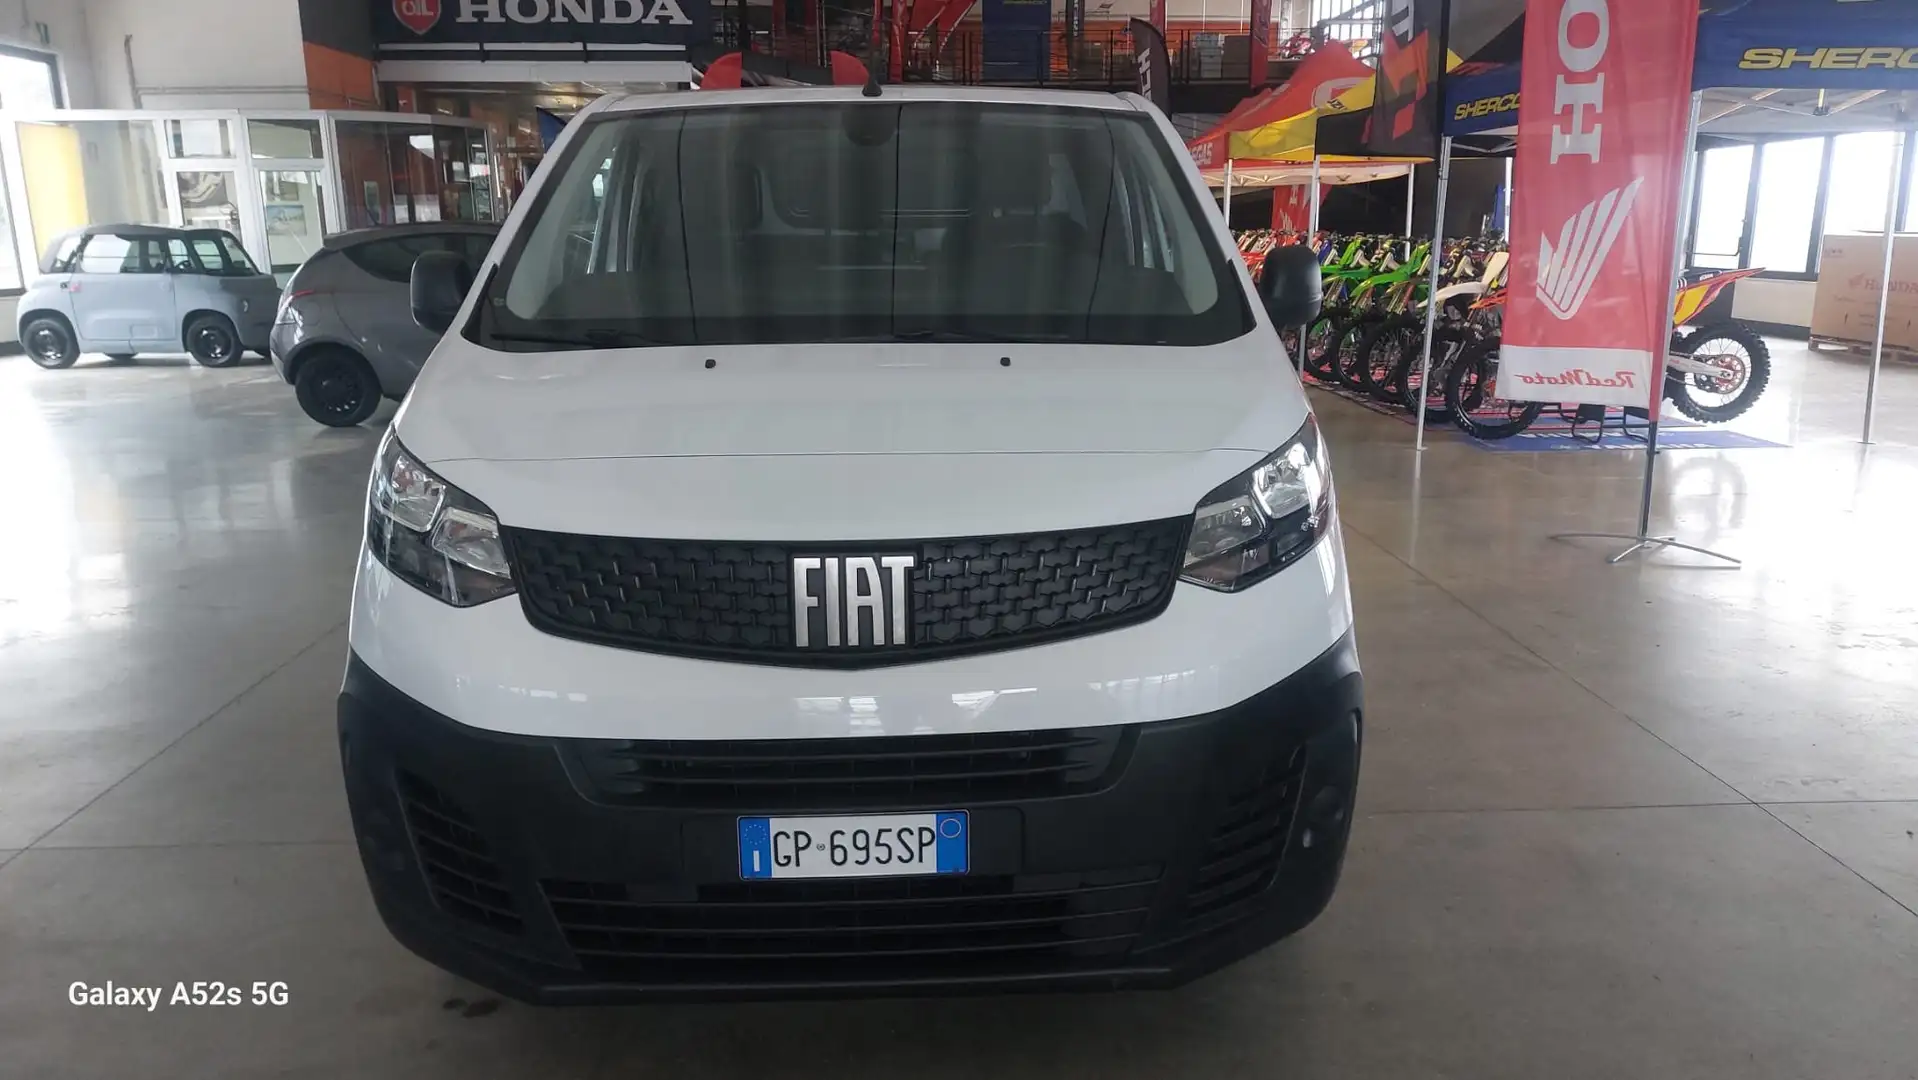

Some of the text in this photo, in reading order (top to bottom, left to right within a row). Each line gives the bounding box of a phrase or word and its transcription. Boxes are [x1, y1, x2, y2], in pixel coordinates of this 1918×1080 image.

[455, 0, 693, 25] HONDA
[793, 555, 915, 647] FIAT
[773, 830, 812, 867] GP
[829, 826, 936, 866] 695SP
